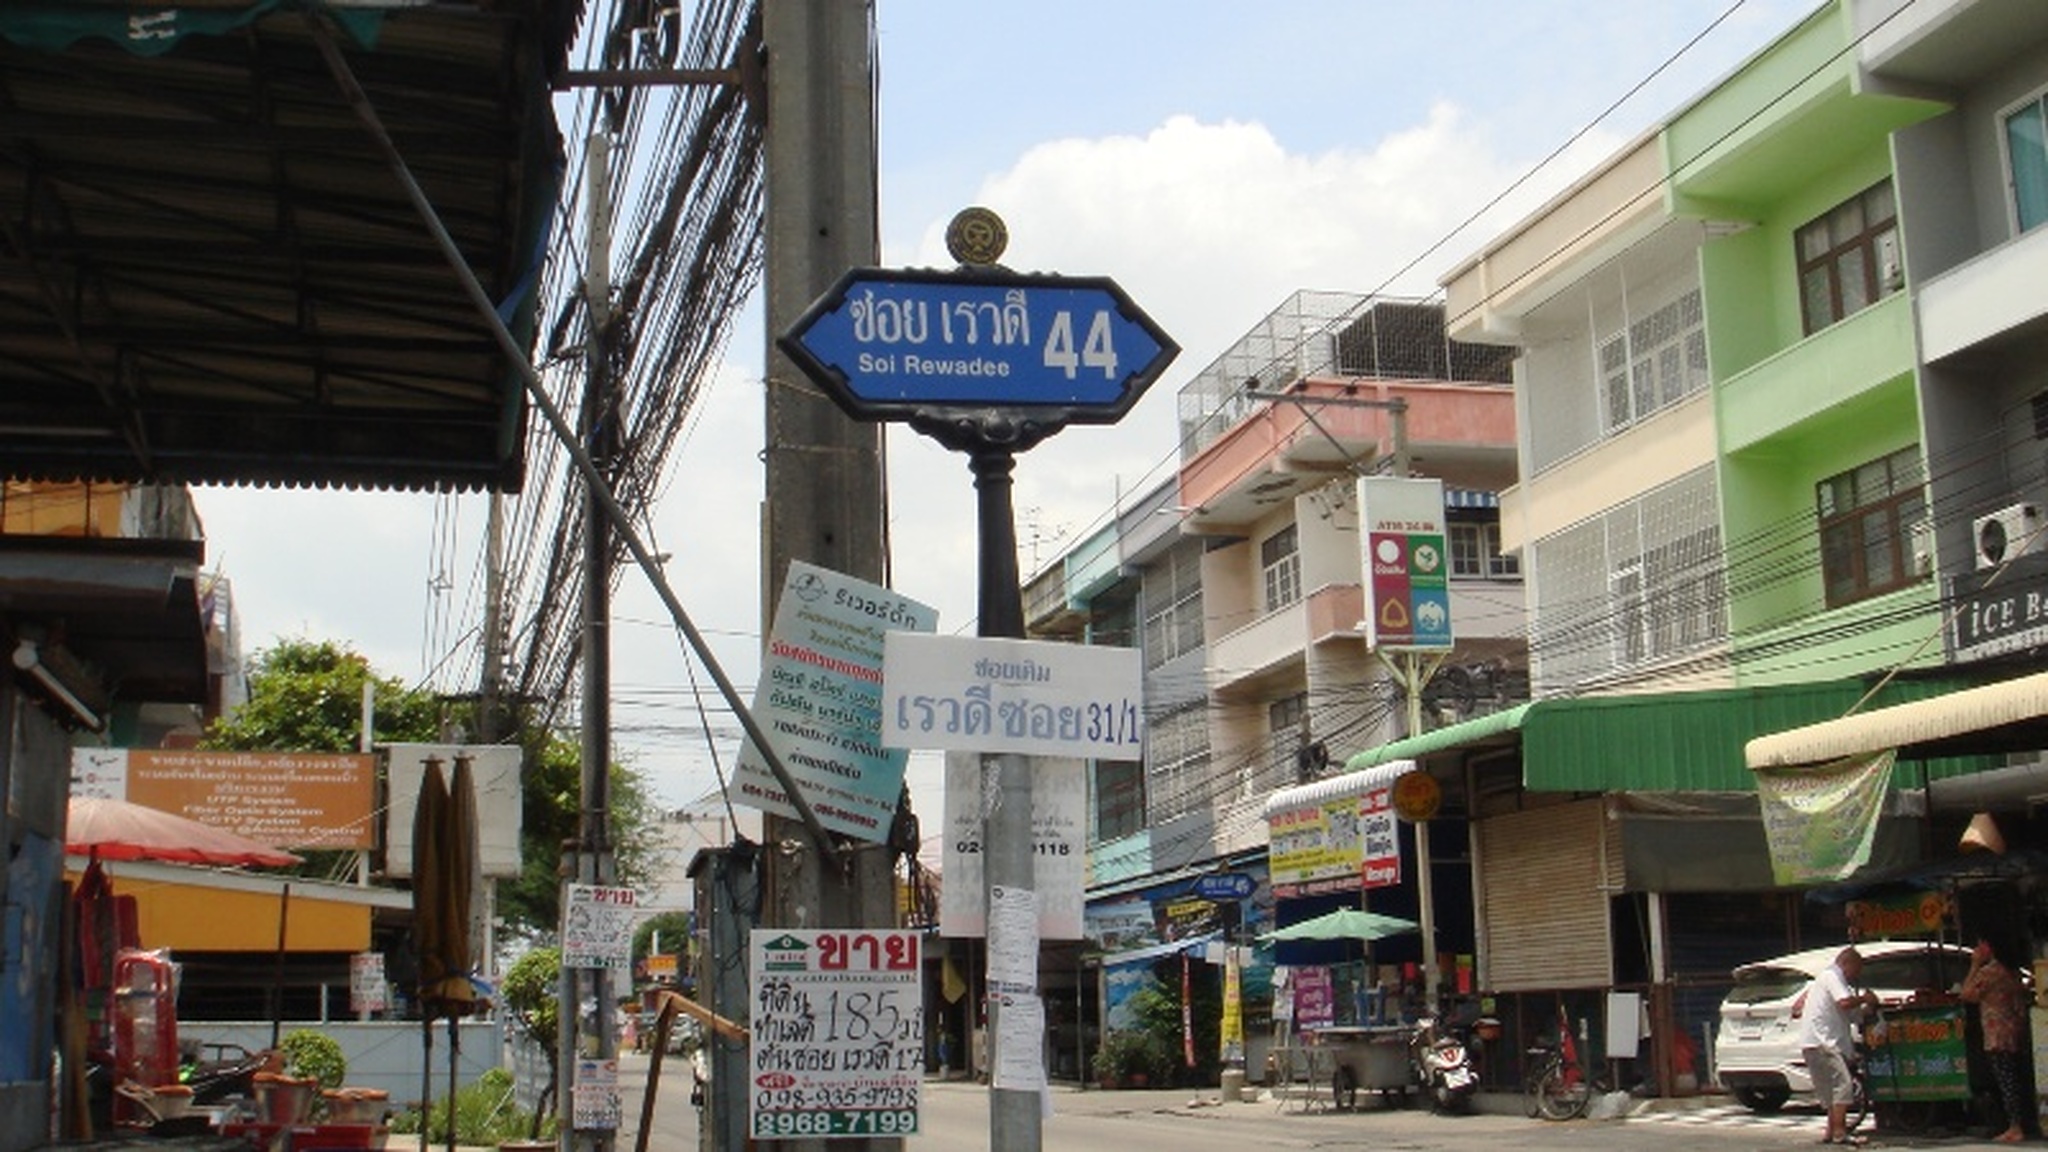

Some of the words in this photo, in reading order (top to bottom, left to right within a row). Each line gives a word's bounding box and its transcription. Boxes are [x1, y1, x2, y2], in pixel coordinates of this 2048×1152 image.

[849, 289, 929, 344] ซอย
[941, 289, 1030, 347] เรวดี
[1043, 310, 1119, 380] 44
[858, 353, 895, 374] Soi
[904, 355, 1010, 377] Rewadee
[974, 657, 1051, 682] ซอยเดิม
[816, 934, 917, 971] ขาย
[824, 989, 900, 1042] 185
